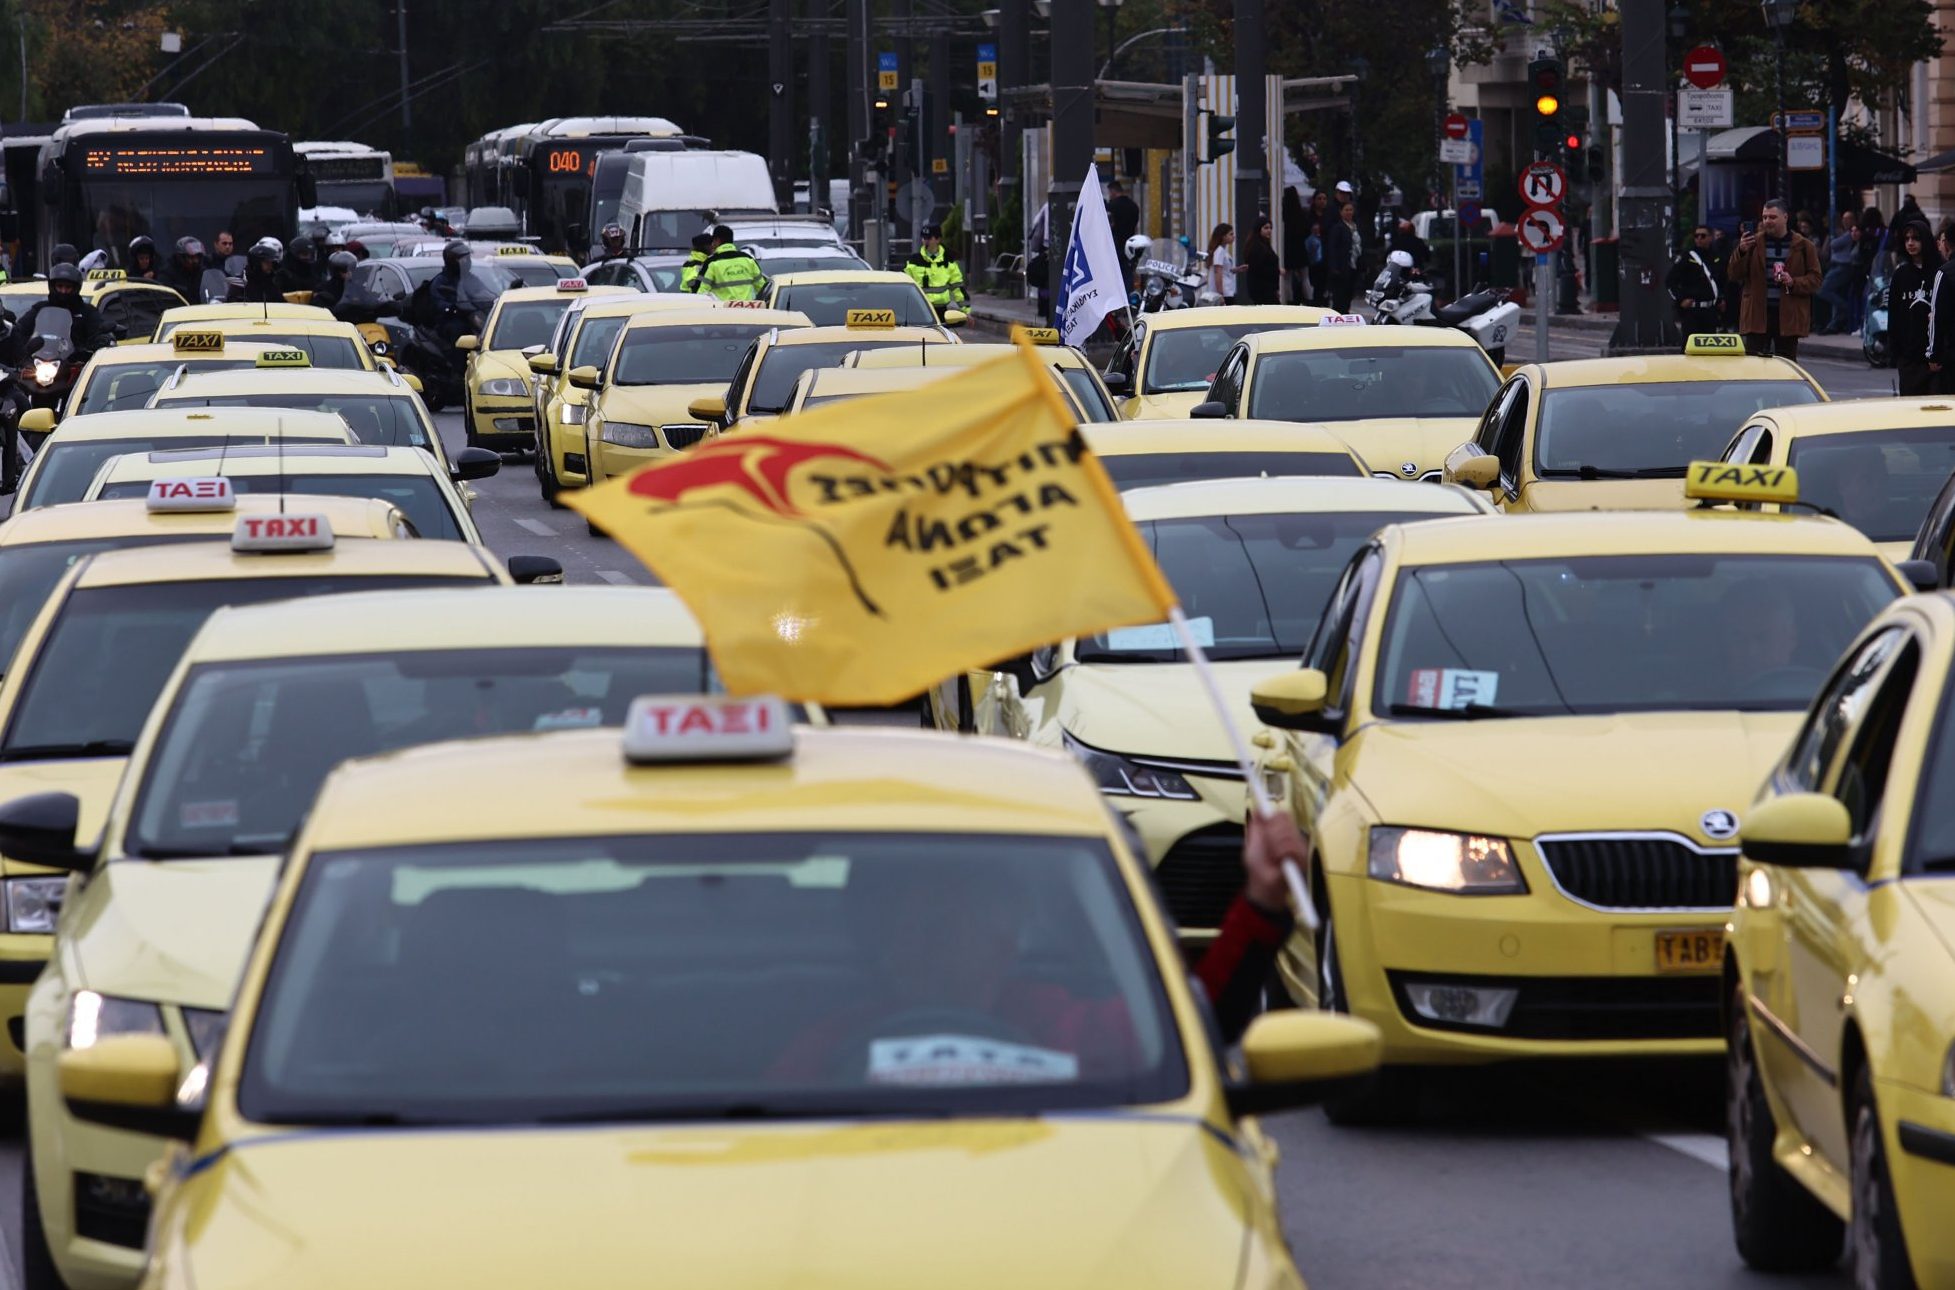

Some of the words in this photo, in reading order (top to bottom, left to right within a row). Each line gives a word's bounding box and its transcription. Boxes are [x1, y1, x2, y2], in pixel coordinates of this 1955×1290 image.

[550, 152, 580, 171] 040
[728, 300, 763, 309] TAXI
[852, 312, 892, 322] TAXI
[1025, 329, 1052, 338] AXI
[177, 335, 219, 347] TAXI
[1696, 337, 1735, 346] TAXI
[265, 352, 301, 360] TAXI
[1697, 465, 1786, 487] TAXI
[154, 482, 226, 498] ΤΑΞΙ
[245, 518, 317, 538] TAXI
